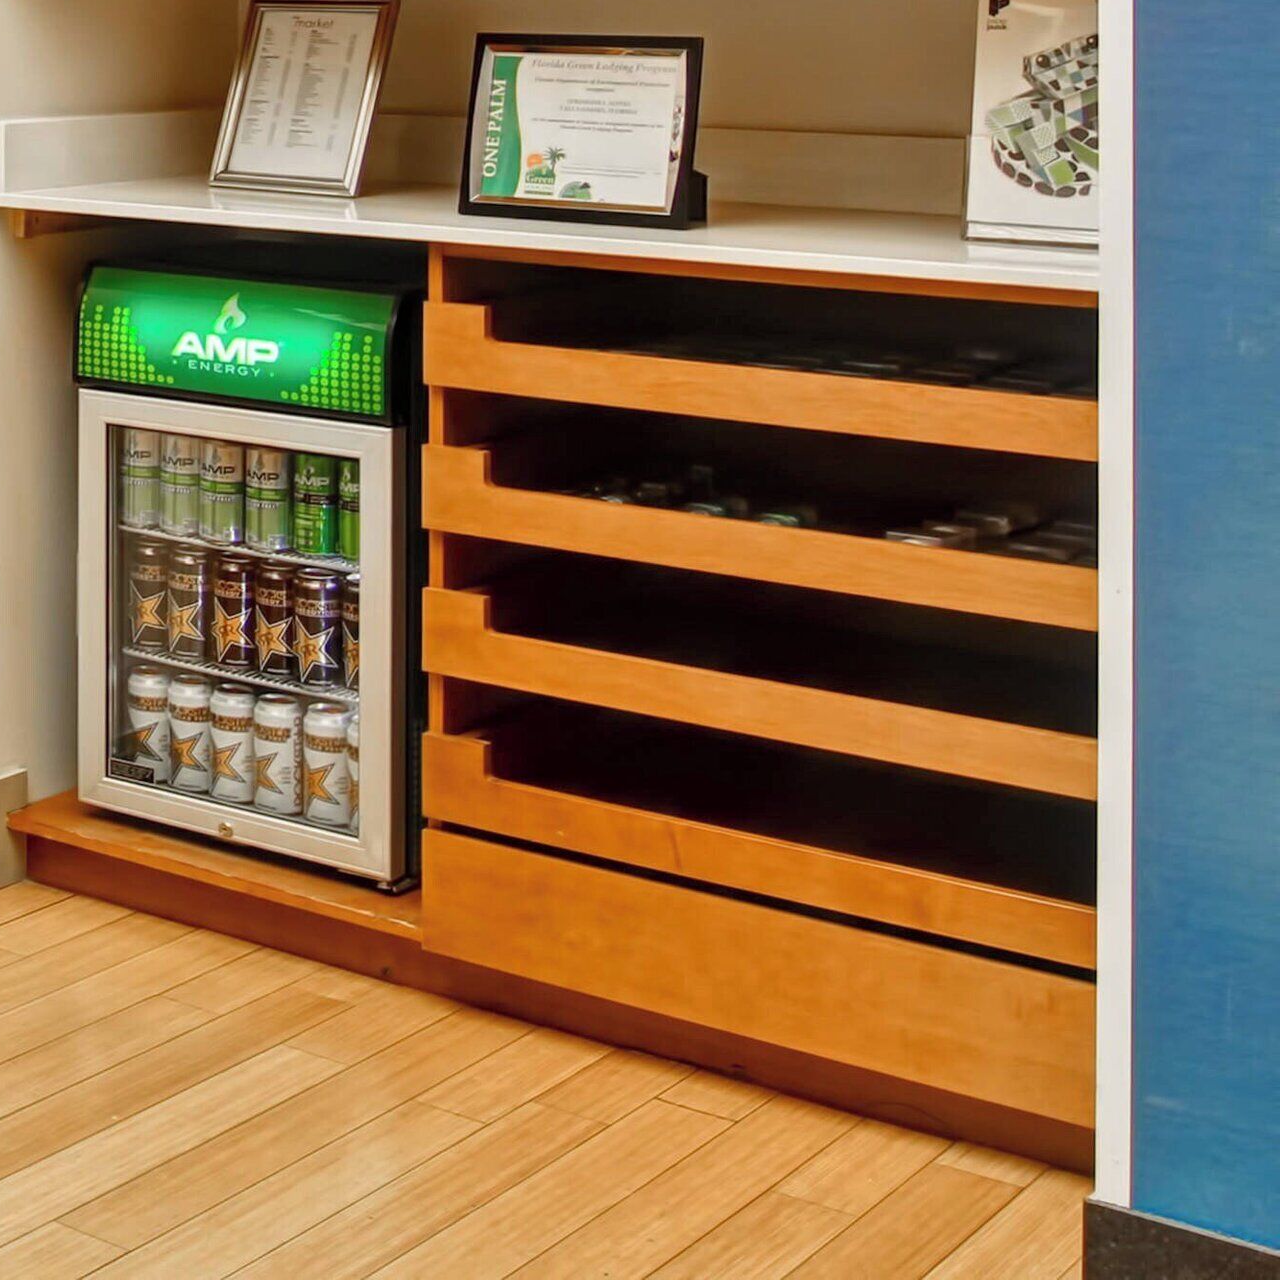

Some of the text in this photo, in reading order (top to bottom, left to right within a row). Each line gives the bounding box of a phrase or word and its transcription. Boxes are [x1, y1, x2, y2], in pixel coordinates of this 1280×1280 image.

[293, 18, 335, 30] market
[595, 60, 634, 74] Lodging
[483, 78, 508, 178] ONE PALM
[171, 331, 280, 366] AMP
[187, 359, 262, 378] ENERGY
[161, 456, 195, 467] AMP
[200, 462, 236, 475] AMP
[247, 469, 280, 482] AMP
[294, 473, 331, 487] AMP
